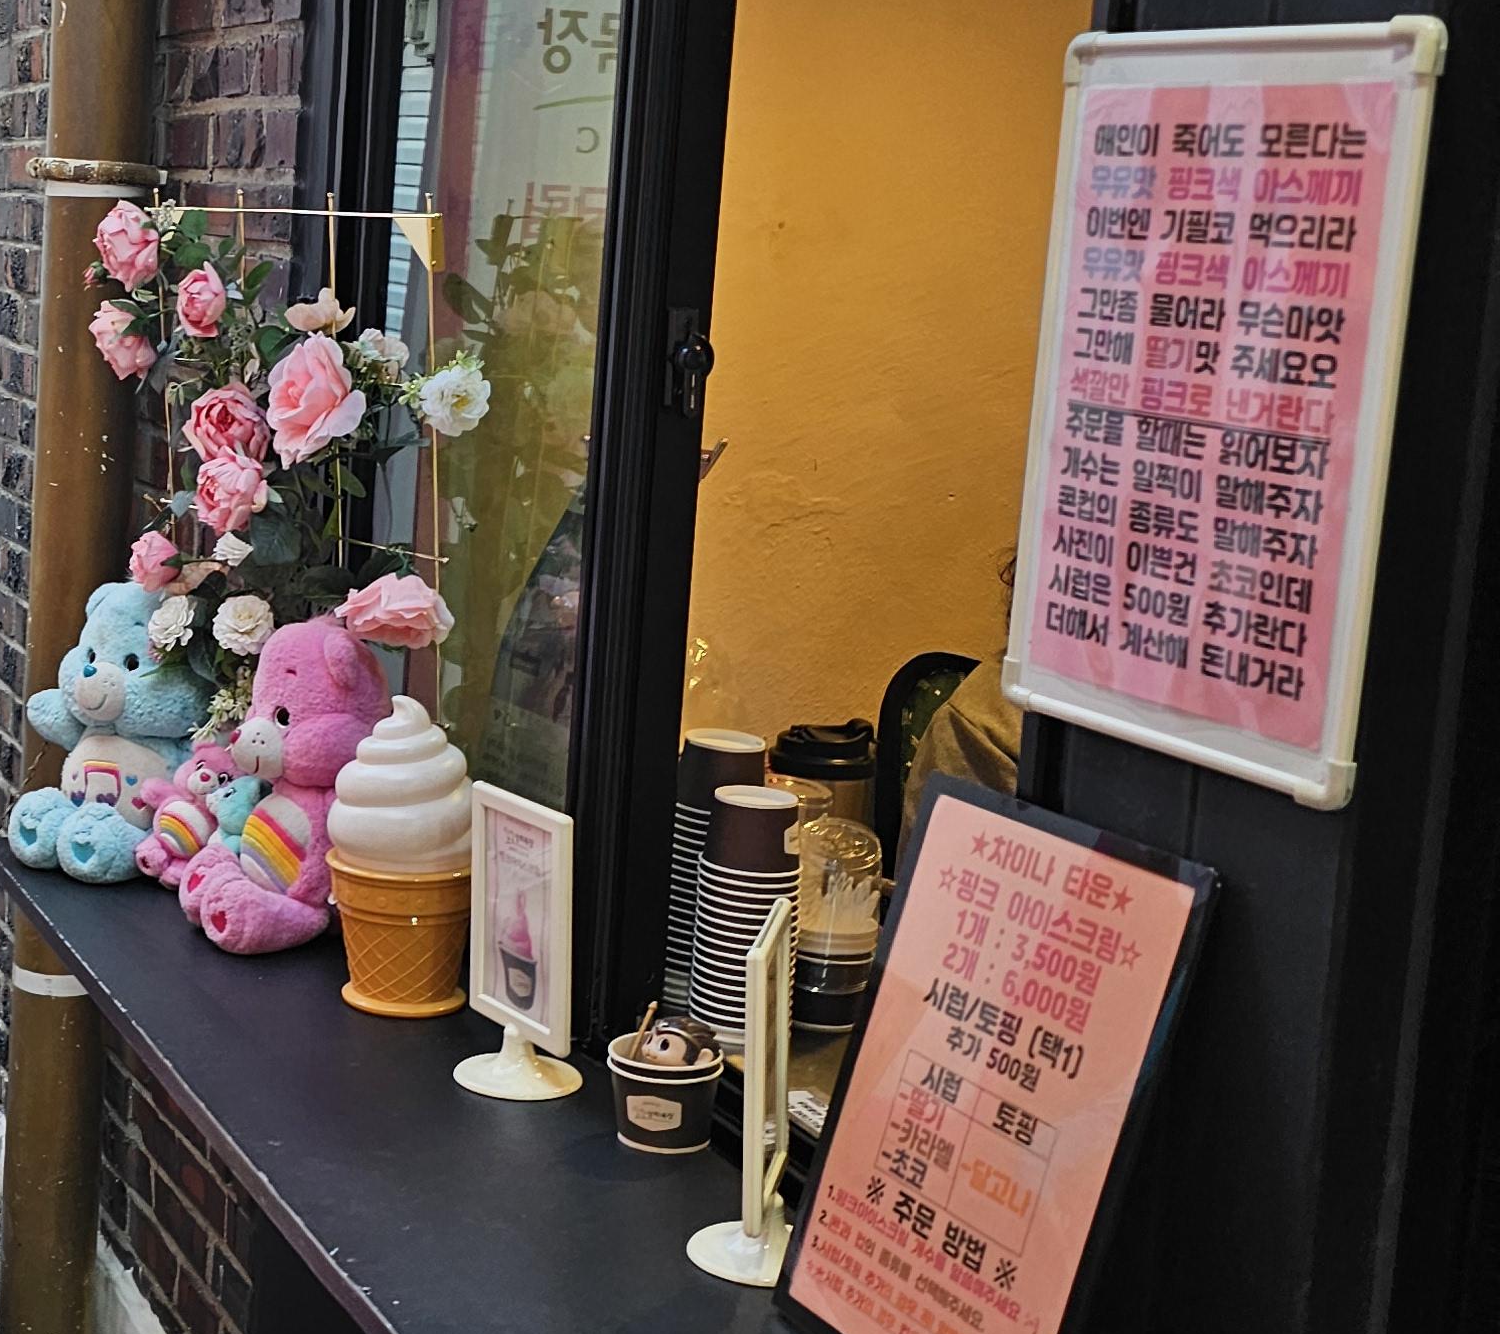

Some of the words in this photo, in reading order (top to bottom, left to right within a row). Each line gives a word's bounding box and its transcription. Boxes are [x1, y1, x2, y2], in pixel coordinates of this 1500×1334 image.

[1172, 123, 1244, 157] 죽어도
[1257, 122, 1366, 159] 모른다는
[1090, 164, 1156, 199] 우유맛
[1168, 166, 1241, 202] 핑크색
[1086, 206, 1150, 240] 이번엔
[1160, 209, 1234, 244] 기필코
[1249, 213, 1355, 251] 먹으리라
[1082, 246, 1144, 283] 우유맛
[1155, 251, 1229, 288] 핑크색
[1077, 287, 1137, 323] 그만좀
[1150, 293, 1225, 331] 물어라
[1238, 300, 1344, 343] 무슨마앗
[1073, 327, 1133, 364] 그만해
[1146, 335, 1220, 375] 딸기맛
[1231, 345, 1337, 388] 주세요오
[1140, 377, 1211, 416] 핑크로
[1065, 402, 1125, 445] 주문을
[1136, 413, 1207, 459] 할때는
[1219, 427, 1328, 478] 읽어보자
[1061, 446, 1119, 486] 개수는
[1132, 459, 1201, 502] 일찍이
[1216, 474, 1322, 523] 말해주자
[1057, 485, 1116, 526] 콘컵의
[1129, 500, 1198, 543] 종류도
[1213, 517, 1316, 568] 말해주자
[1052, 525, 1113, 566] 사진이
[1126, 541, 1196, 585] 이쁜건
[1208, 560, 1312, 613] 초코인데
[1048, 564, 1110, 606] 시럽은
[1122, 582, 1190, 626] 500원
[1203, 601, 1306, 656] 추가란다
[1045, 601, 1109, 646] 더해서
[1119, 621, 1188, 668] 계산해
[1200, 642, 1303, 700] 돈내거라
[987, 836, 1055, 886] 차이나
[1062, 864, 1112, 909] 타운
[956, 869, 999, 911] 핑크
[1007, 891, 1120, 963] 아이스크림
[956, 909, 989, 946] 1개
[1011, 933, 1101, 995] 3,500원
[923, 978, 1021, 1045] 시럽/토핑
[942, 942, 979, 982] 2개
[1002, 970, 1090, 1033] 6,000원
[920, 1062, 963, 1103] 시럽
[946, 1026, 982, 1061] 추가
[986, 1047, 1040, 1092] 500원
[992, 1101, 1039, 1145] 토핑
[892, 1190, 935, 1239] 주문
[942, 1221, 986, 1273] 방법
